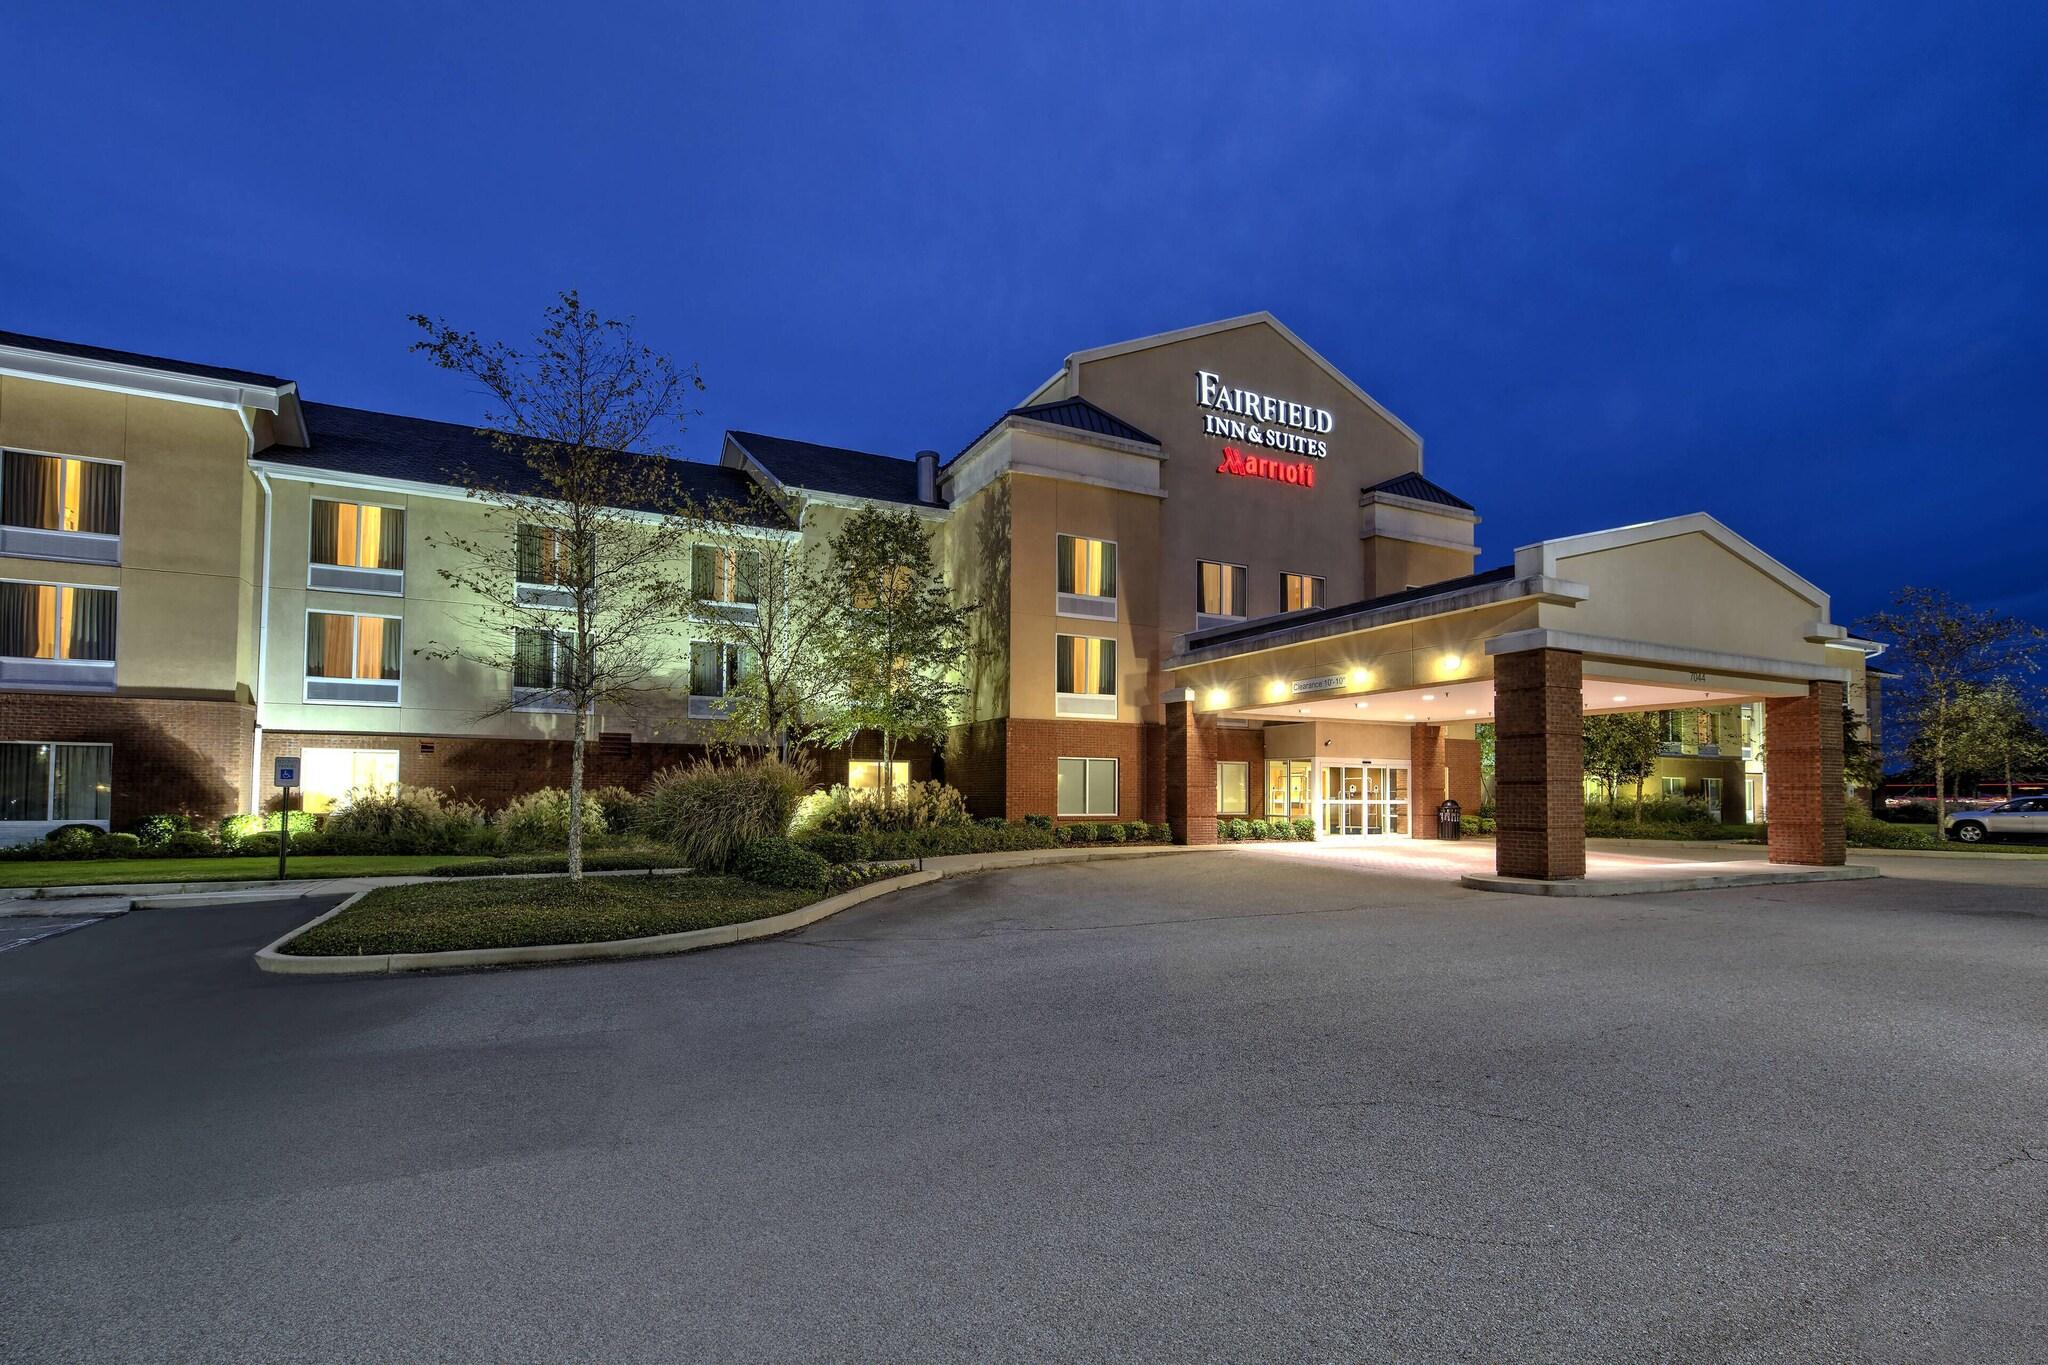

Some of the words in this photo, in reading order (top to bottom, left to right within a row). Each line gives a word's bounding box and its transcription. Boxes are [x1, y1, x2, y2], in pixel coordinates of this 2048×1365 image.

[1196, 370, 1333, 433] FAIRFIELD
[1204, 414, 1246, 440] INN
[1248, 424, 1263, 444] &
[1265, 428, 1328, 458] SUITES
[1216, 446, 1314, 487] Marriott
[1293, 681, 1323, 691] Clearance
